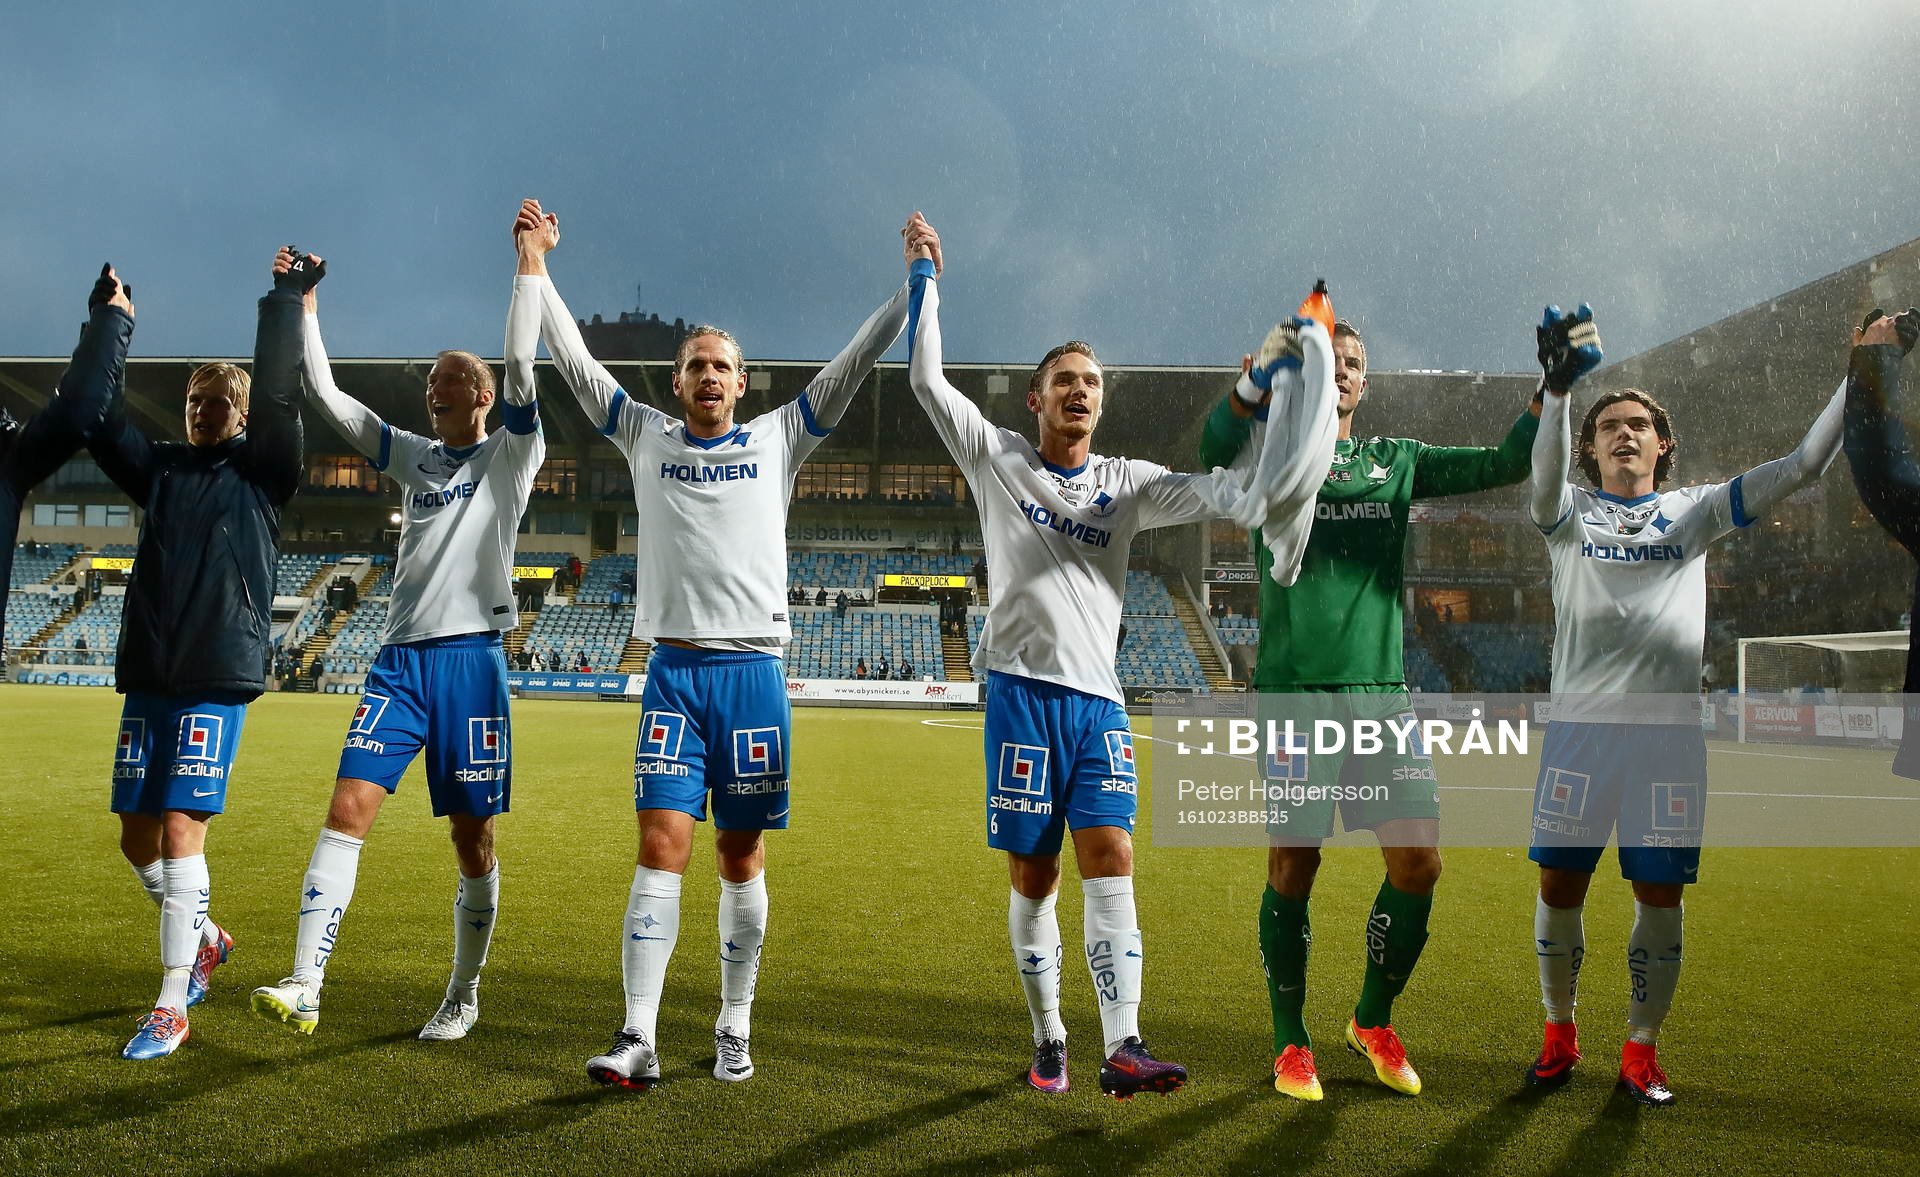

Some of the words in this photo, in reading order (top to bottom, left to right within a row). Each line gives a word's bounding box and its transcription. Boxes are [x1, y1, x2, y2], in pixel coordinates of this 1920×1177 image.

[293, 260, 304, 272] 4
[660, 462, 758, 482] HOLMEN
[412, 480, 481, 509] HOLME
[1315, 502, 1392, 520] OLMEN
[1020, 499, 1112, 548] HOLMEN
[786, 523, 893, 543] elsbanken
[1580, 540, 1684, 562] HOLMEN
[900, 575, 950, 587] PACKOPLOCK
[1228, 571, 1254, 581] pepsi
[552, 680, 571, 688] KPMG
[576, 680, 595, 688] KPMG
[600, 681, 620, 689] KPMG
[834, 687, 912, 696] www.abysnickeri.se
[924, 685, 948, 696] ABY
[1754, 706, 1798, 721] XERVON
[170, 761, 224, 780] stadium
[454, 766, 507, 783] stadium
[634, 759, 689, 778] stadium
[726, 777, 790, 796] stadium
[990, 794, 1053, 815] stadium
[990, 813, 998, 834] 6
[1532, 813, 1591, 838] stadium
